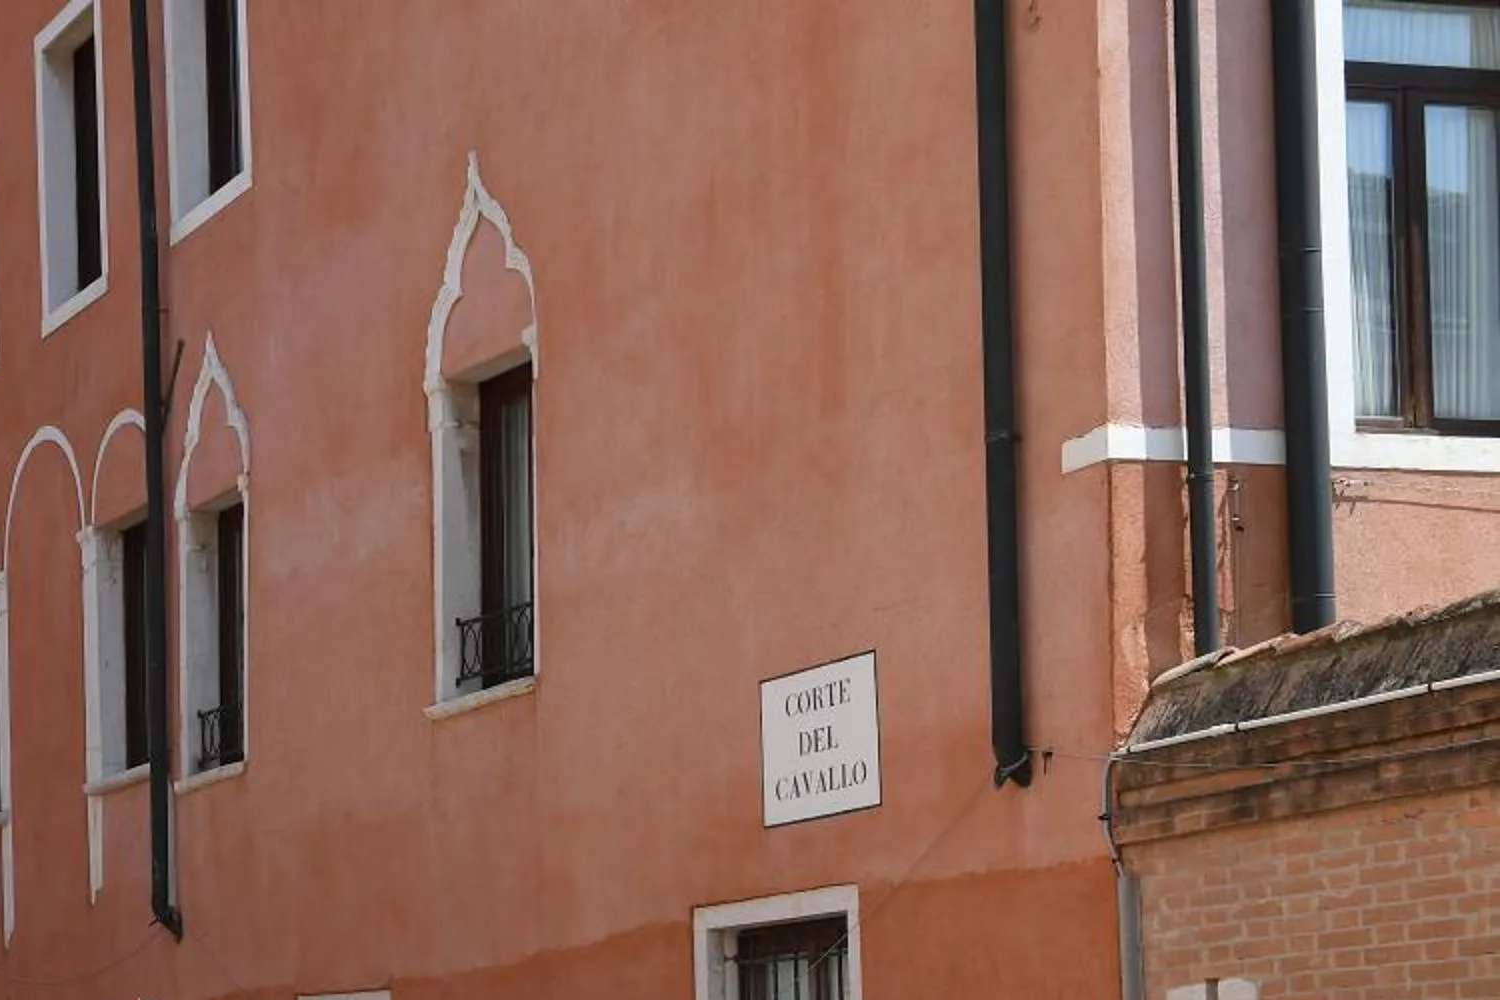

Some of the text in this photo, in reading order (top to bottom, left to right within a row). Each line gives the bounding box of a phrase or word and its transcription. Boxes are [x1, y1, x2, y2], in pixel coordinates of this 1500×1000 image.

[784, 678, 851, 717] CORTE
[799, 725, 839, 757] DEL
[774, 760, 868, 802] CAVALLO
